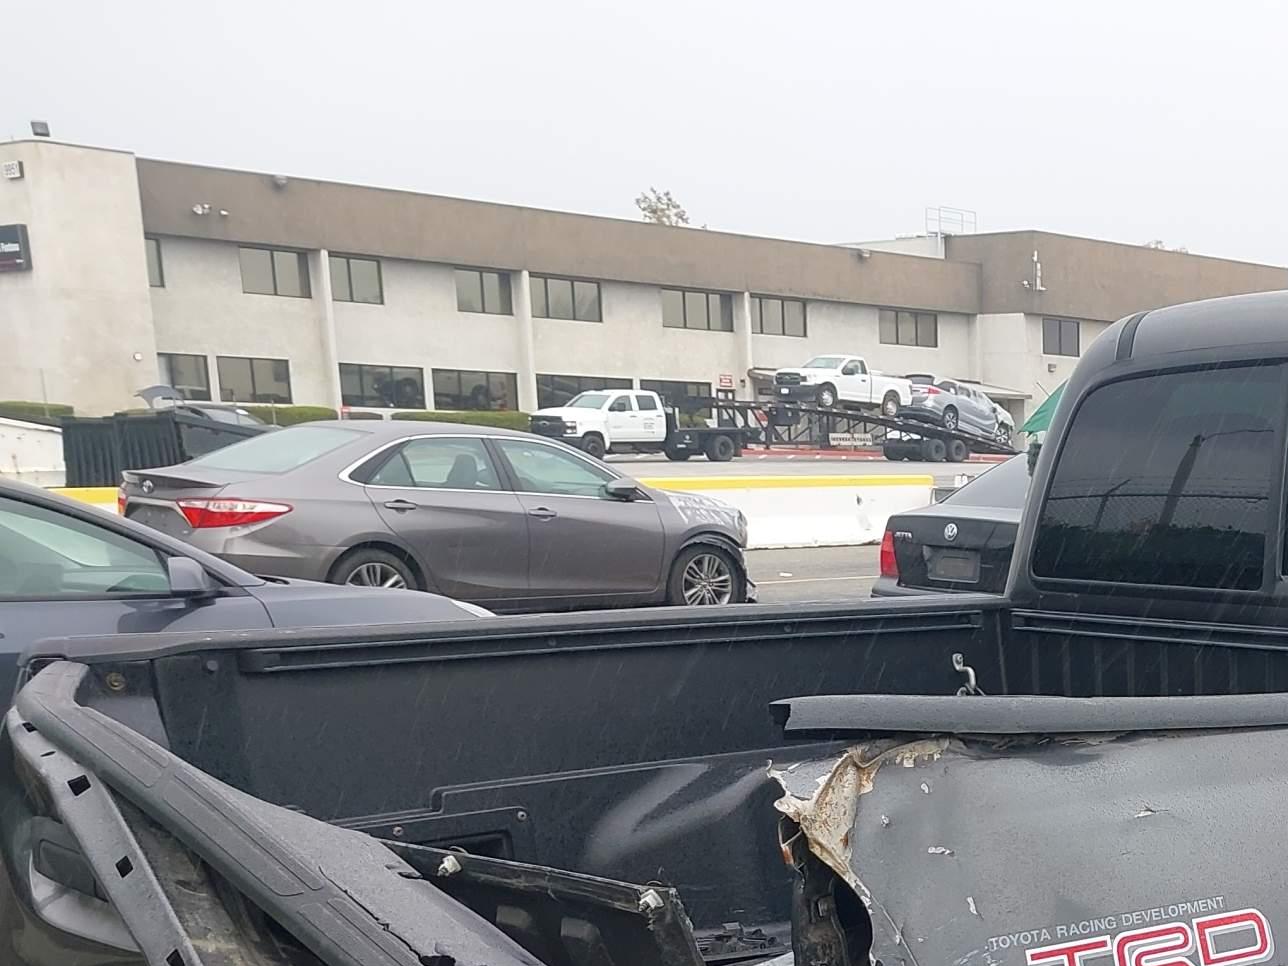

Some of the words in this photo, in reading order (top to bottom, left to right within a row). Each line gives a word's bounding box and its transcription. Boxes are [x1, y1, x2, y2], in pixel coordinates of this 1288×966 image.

[987, 928, 1051, 952] TOYOTA
[1056, 916, 1117, 939] RACING
[1122, 896, 1224, 926] DEVELOPMENT
